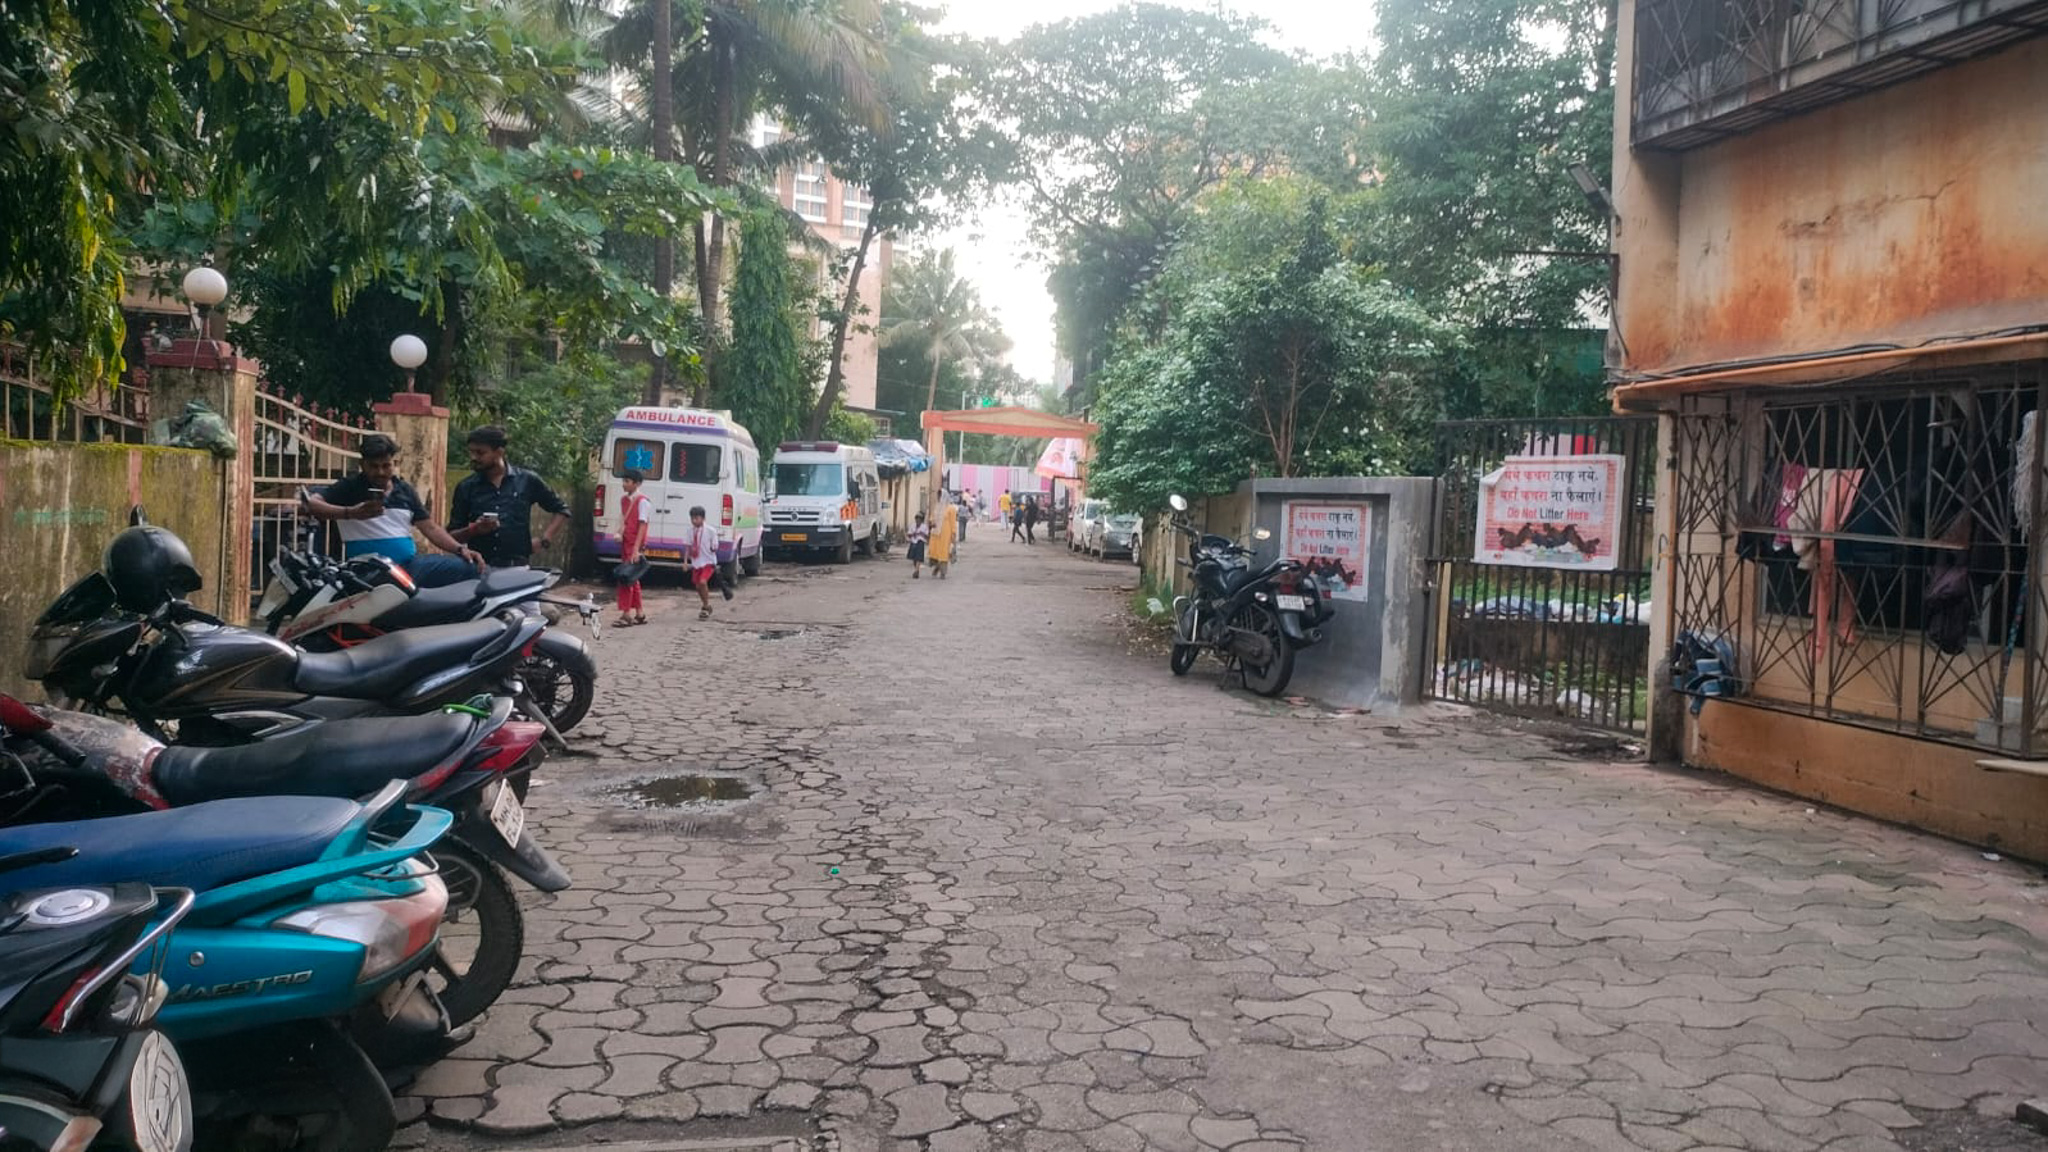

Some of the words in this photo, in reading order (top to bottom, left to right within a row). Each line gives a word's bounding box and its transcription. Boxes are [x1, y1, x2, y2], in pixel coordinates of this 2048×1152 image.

[626, 409, 716, 427] AMBULANCE
[1550, 491, 1563, 502] ना
[1507, 507, 1519, 519] Do
[1522, 508, 1537, 519] Not
[1539, 507, 1564, 520] Litter
[1567, 509, 1589, 521] Here
[168, 969, 314, 1001] MAESTRO
